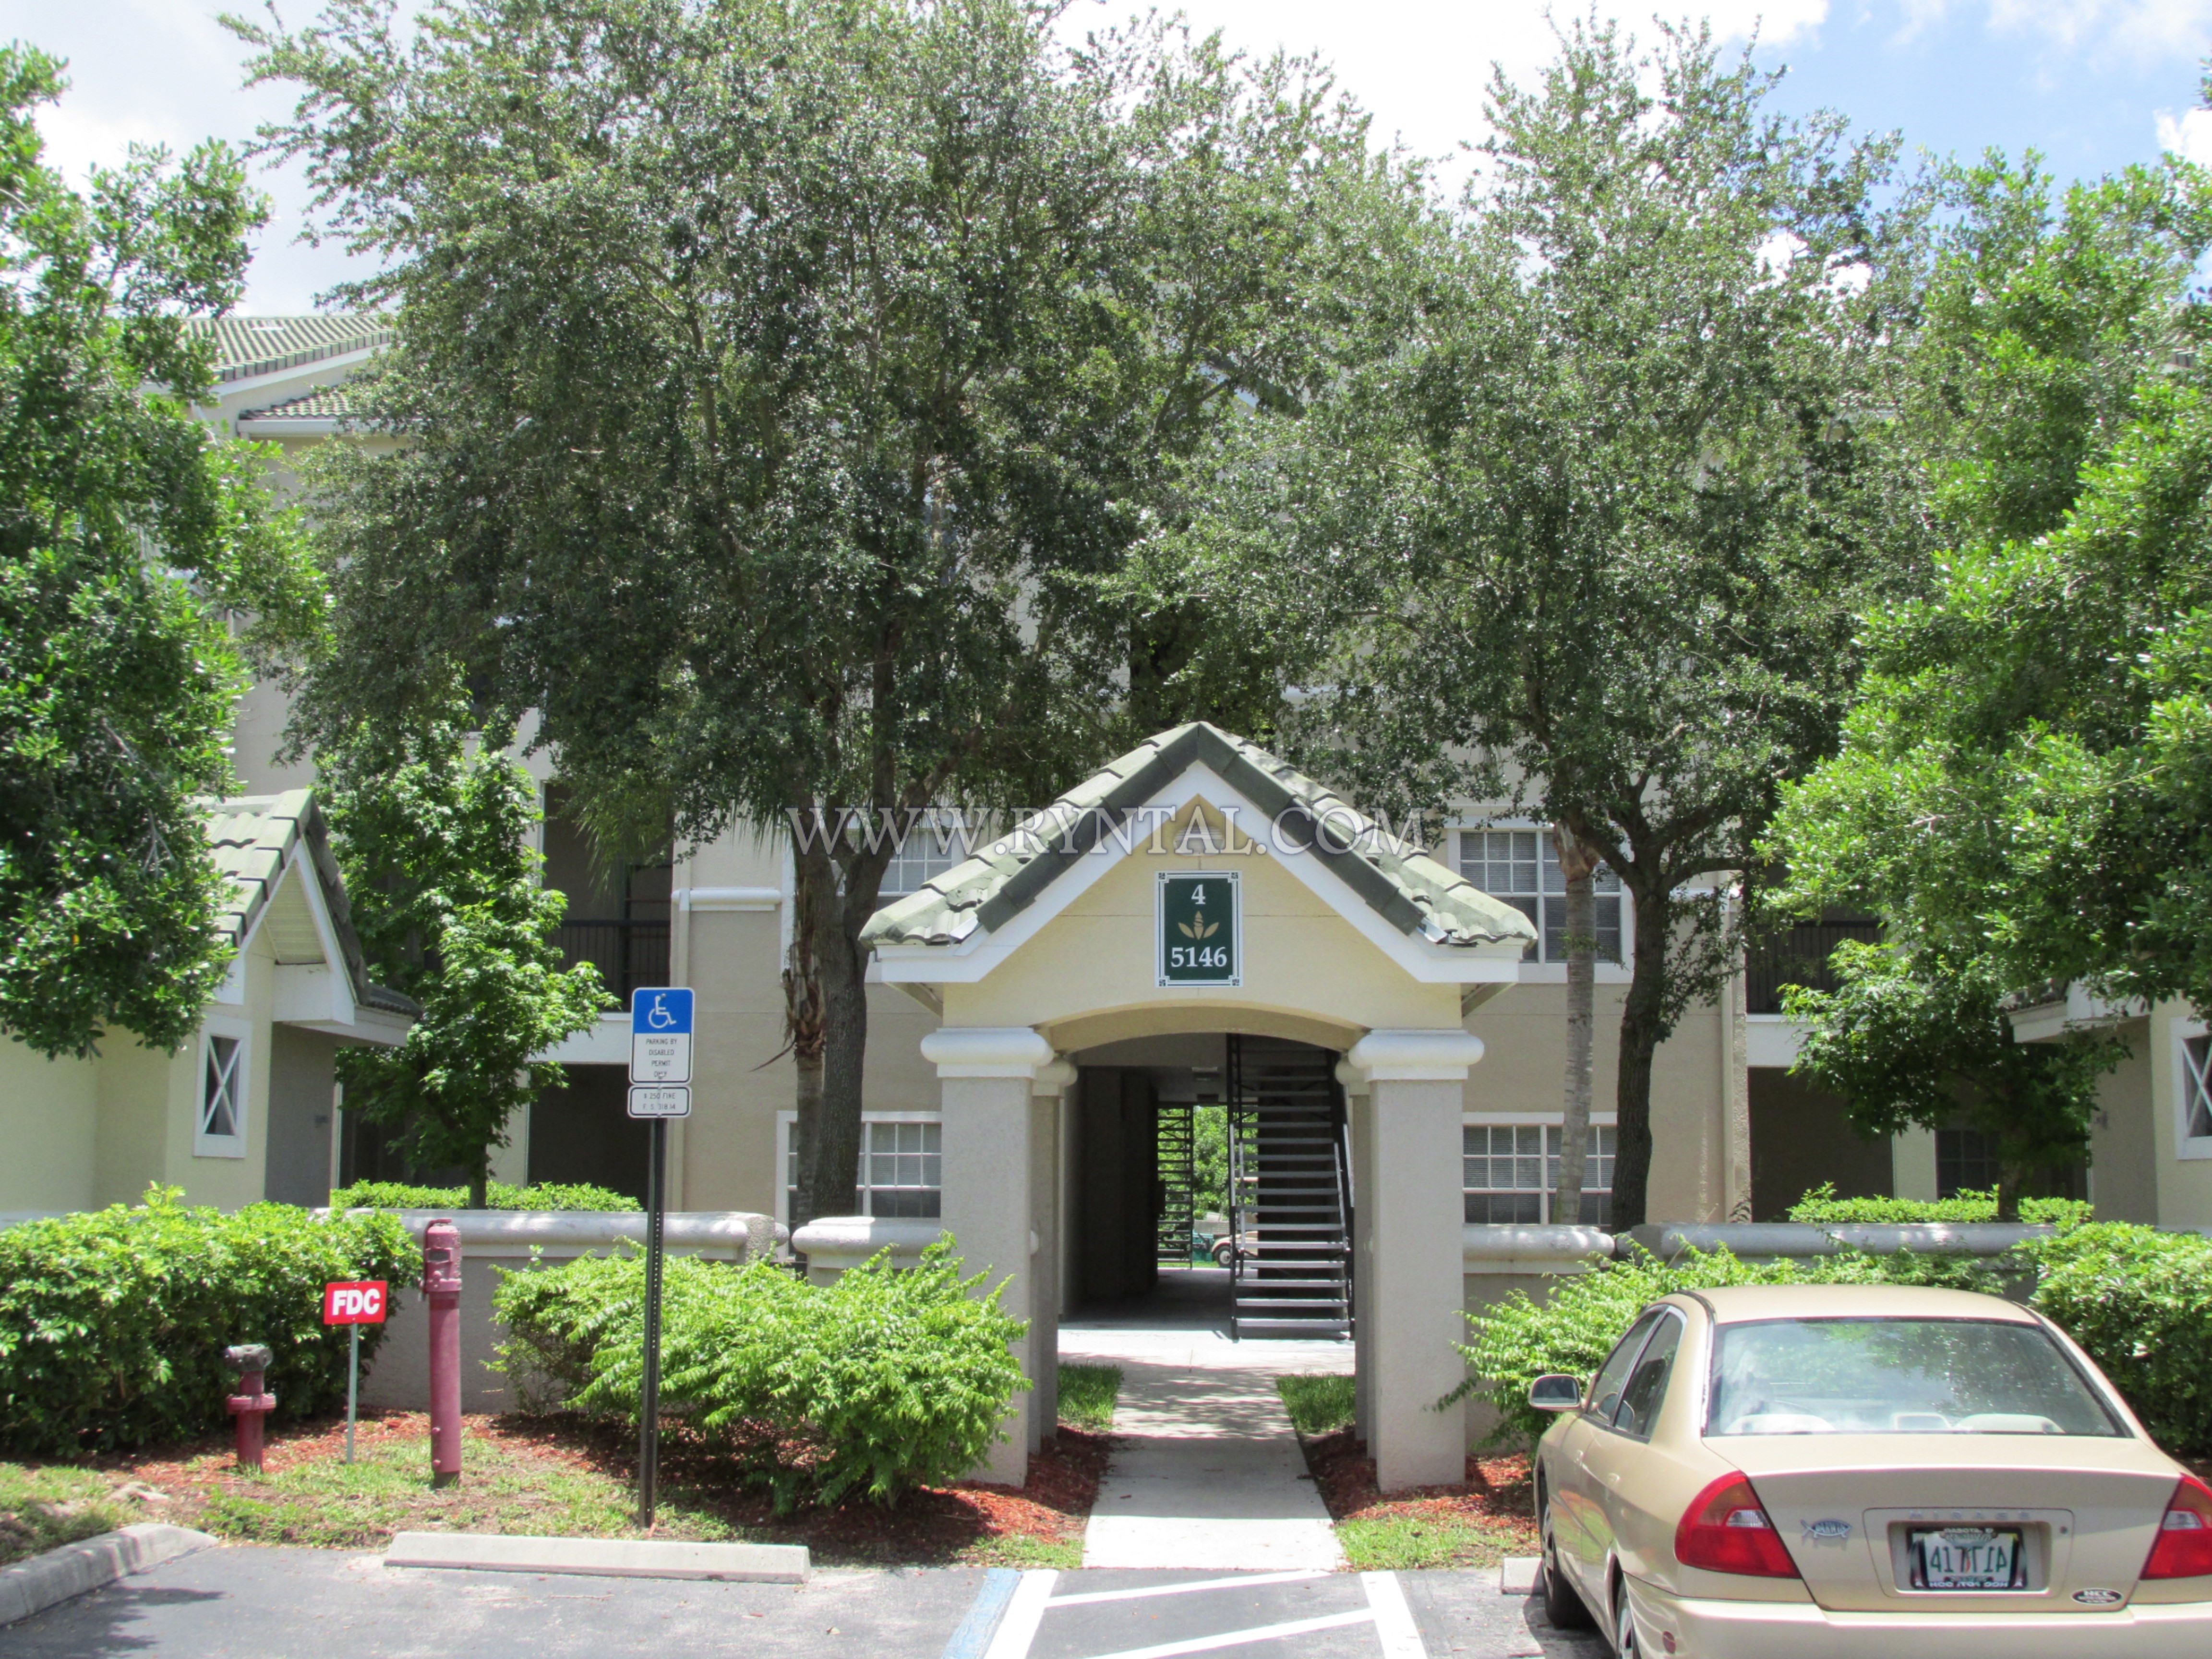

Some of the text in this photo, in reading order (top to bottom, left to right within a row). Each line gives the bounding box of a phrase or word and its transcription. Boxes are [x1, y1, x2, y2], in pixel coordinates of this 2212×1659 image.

[1190, 884, 1206, 905] 4
[1170, 946, 1228, 968] 5146
[332, 1288, 381, 1316] FDC
[1910, 1511, 2031, 1521] MIRAGE
